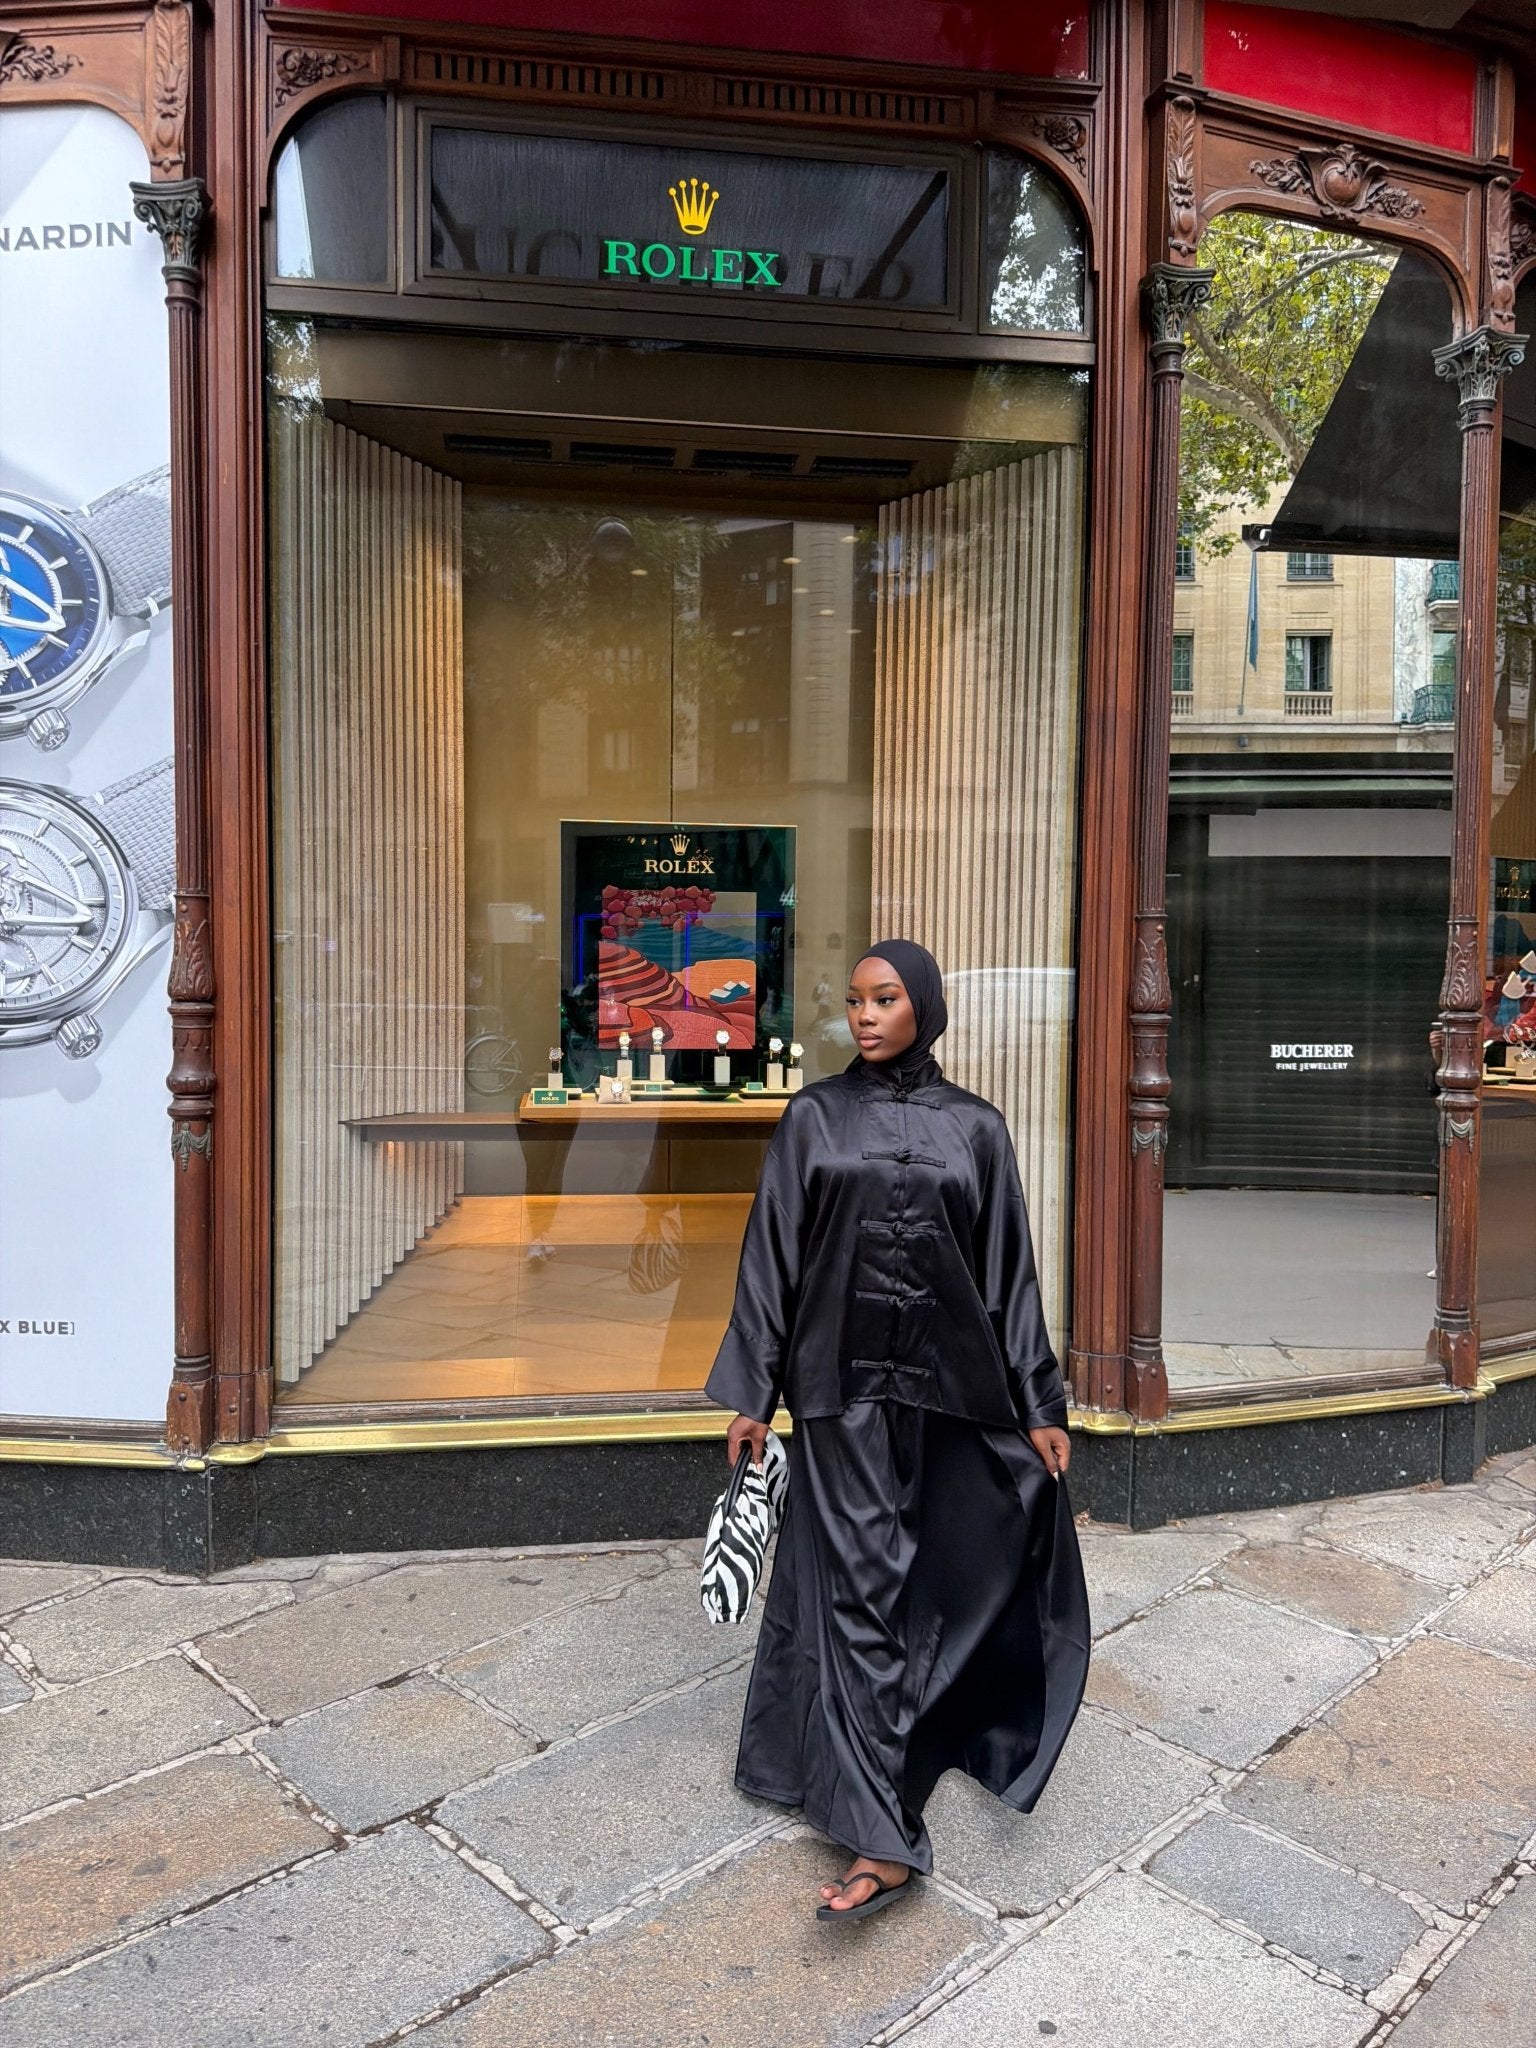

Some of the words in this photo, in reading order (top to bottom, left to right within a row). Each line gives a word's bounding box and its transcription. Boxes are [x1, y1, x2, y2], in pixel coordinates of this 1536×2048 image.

[603, 239, 782, 287] ROLEX
[644, 859, 715, 874] ROLEX
[1269, 1043, 1354, 1058] BUCHERER
[1275, 1062, 1298, 1070] FINE
[1298, 1062, 1348, 1072] JEWELLERY
[0, 1320, 11, 1334] X
